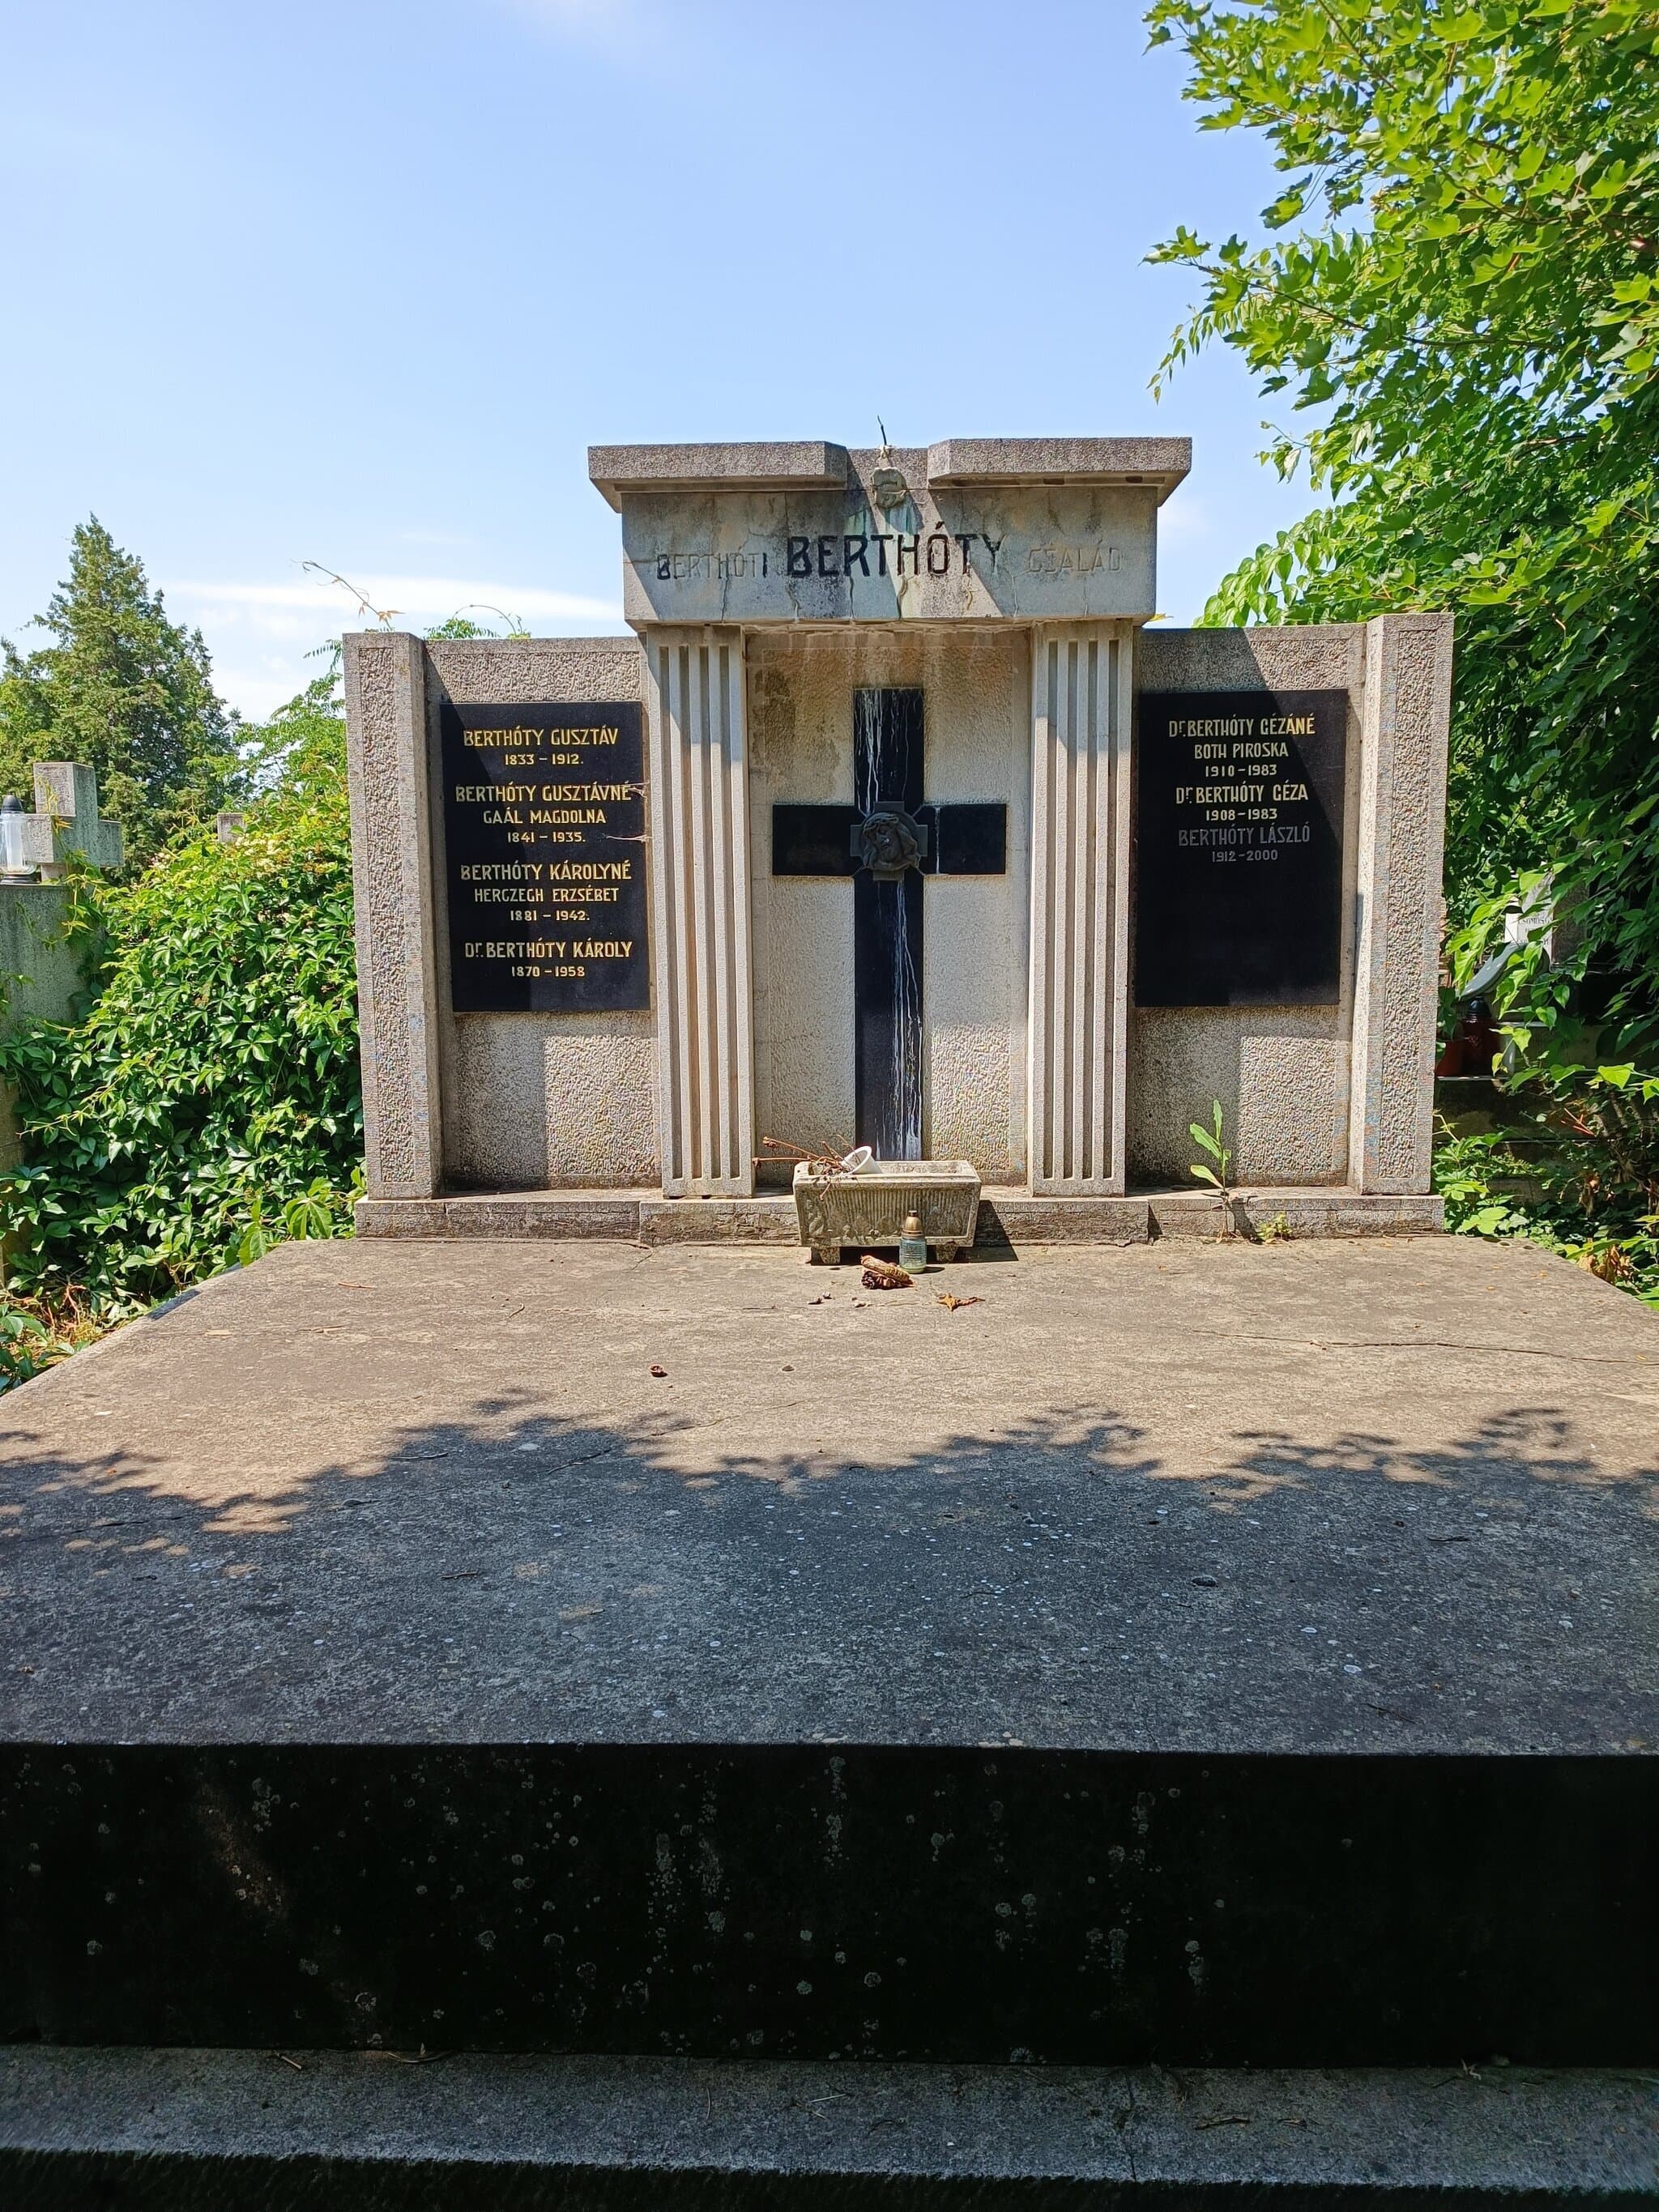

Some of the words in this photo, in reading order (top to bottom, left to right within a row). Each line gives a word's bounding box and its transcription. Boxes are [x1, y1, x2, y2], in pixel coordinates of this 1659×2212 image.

[787, 521, 1005, 578] BERTHÓTY
[1260, 712, 1316, 735] GÉZÁNÉ
[463, 725, 544, 747] BERTHÓTY
[551, 725, 619, 745] GUSZTÁV
[505, 753, 535, 765] 1833
[552, 753, 584, 765] 1912.
[1194, 744, 1227, 760] BOTH
[1232, 742, 1290, 759] PIROSKA
[455, 781, 537, 802] BERTHÓTY
[542, 780, 632, 801] GUSZTÁVNÉ
[1196, 780, 1265, 804] BERTHÓTY
[1273, 779, 1309, 801] GÉZA
[484, 807, 523, 824] GAÁL
[530, 808, 607, 824] MAGDOLNA
[507, 832, 535, 843] 1841
[552, 831, 586, 843] 1935.
[1179, 823, 1255, 846] BERTHÓTY
[1259, 820, 1311, 844] LÁSZLÓ
[460, 859, 544, 880] BERTHÓTY
[549, 859, 632, 880] KÁROLYNÉ
[474, 888, 544, 902] HERCZEGH
[552, 884, 620, 902] ERZSÉBET
[510, 910, 537, 921] 1881
[556, 910, 591, 921] 1942.
[573, 936, 633, 958] KÁROLY
